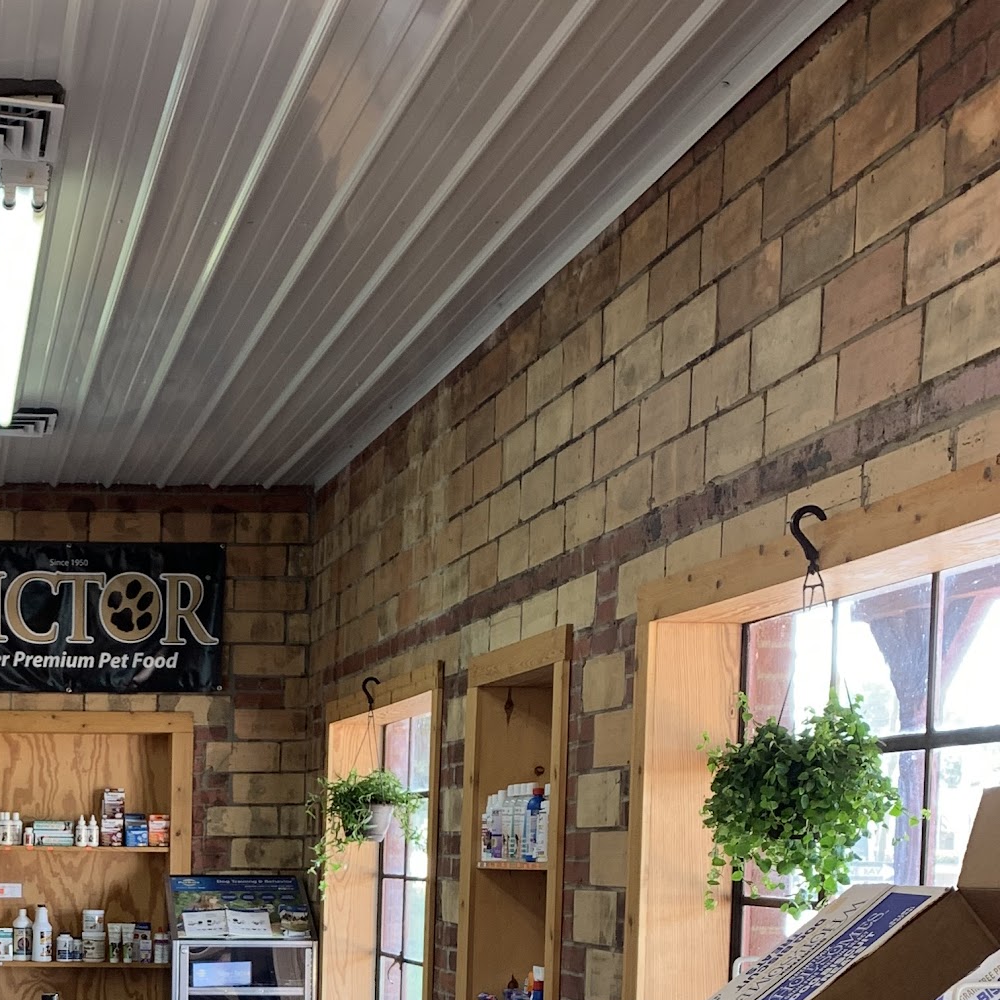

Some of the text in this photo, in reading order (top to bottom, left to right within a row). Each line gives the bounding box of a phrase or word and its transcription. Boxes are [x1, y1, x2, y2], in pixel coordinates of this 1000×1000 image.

[50, 559, 88, 567] Since 1950
[13, 651, 95, 668] Premium
[98, 651, 128, 669] Pet
[132, 652, 178, 669] Food
